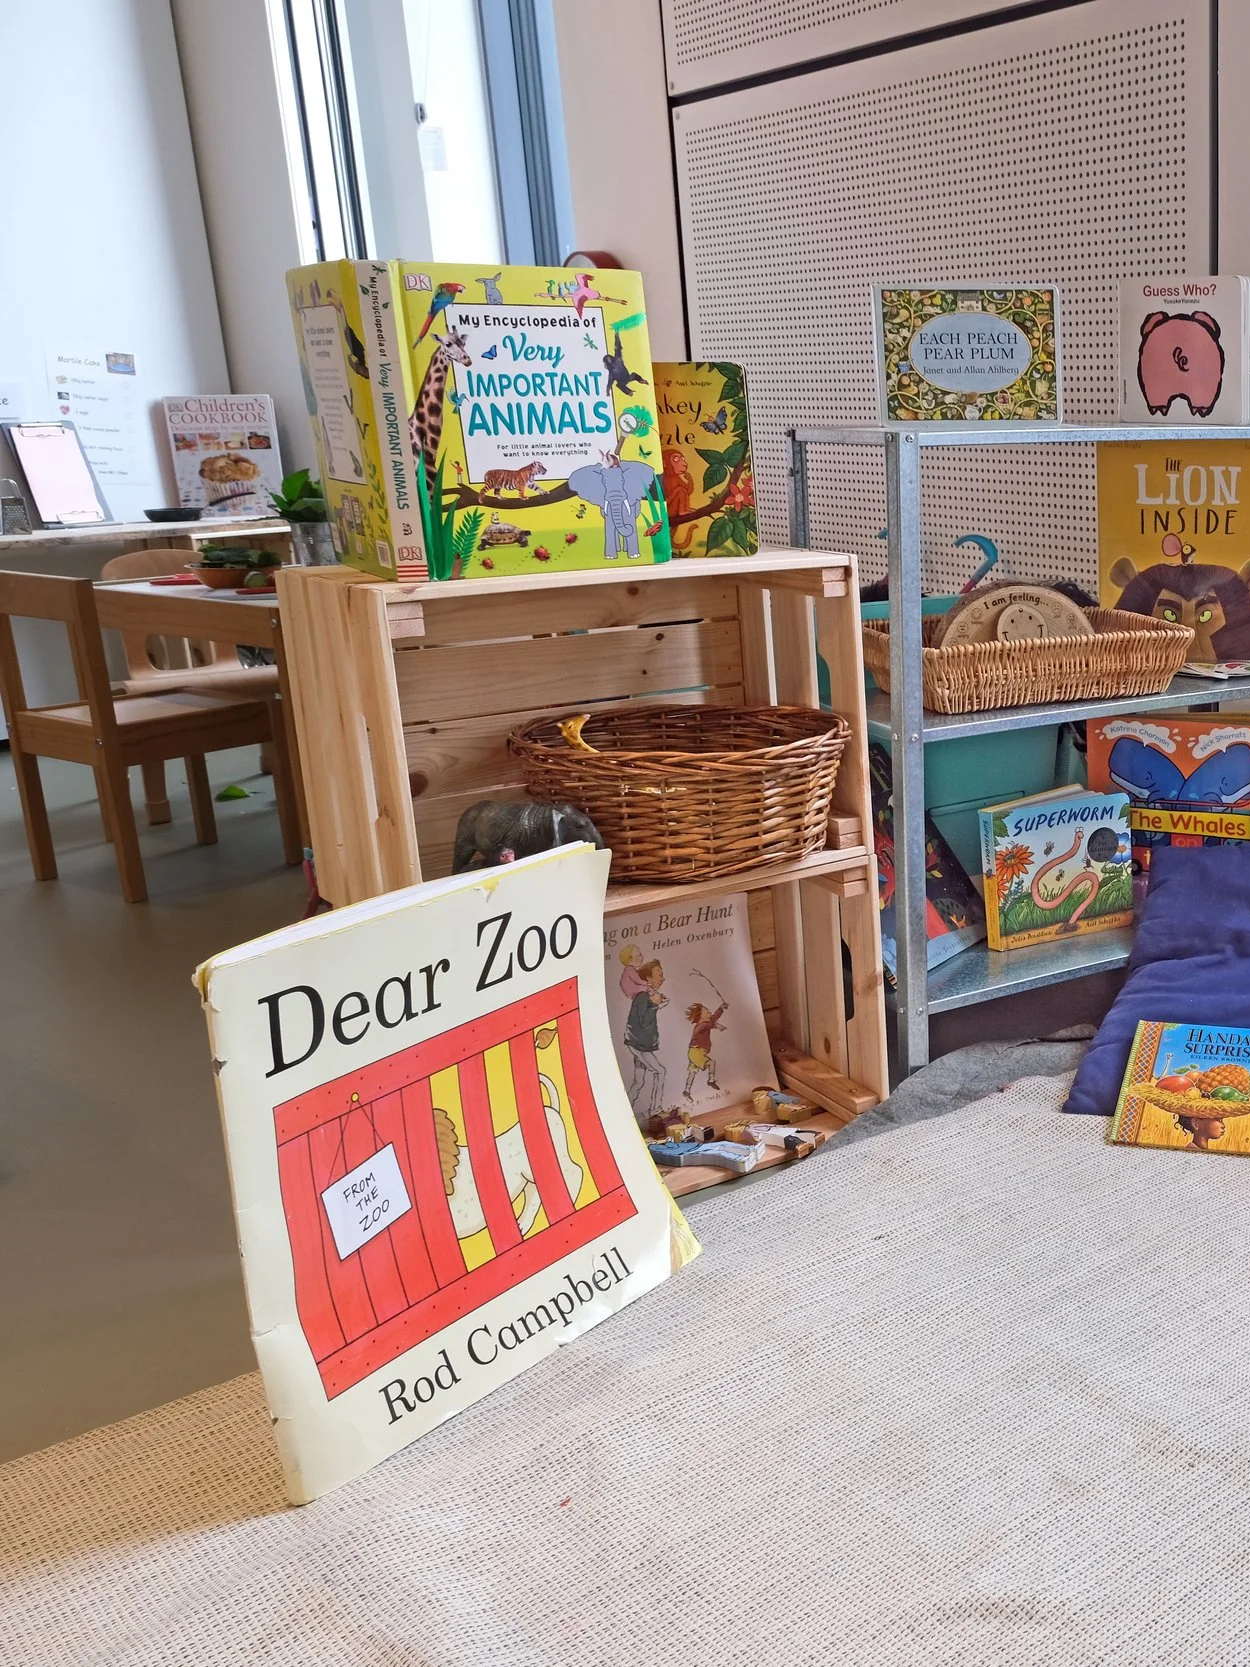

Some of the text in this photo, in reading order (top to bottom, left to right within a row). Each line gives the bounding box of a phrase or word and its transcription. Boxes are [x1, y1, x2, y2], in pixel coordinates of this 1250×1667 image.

[406, 275, 430, 290] DK
[1143, 283, 1217, 297] Guess Who?
[458, 314, 597, 329] My Encyclopedia of
[919, 332, 1018, 345] EACH PEACH
[57, 355, 101, 367] Marble Cake
[502, 332, 565, 369] Very
[924, 347, 1015, 360] PEAR PLUM
[923, 366, 1019, 376] Janet and Allan Ahlberg
[369, 276, 410, 510] My Encyclopedia of Very IMPORTANT ANIMALS
[466, 370, 602, 398] IMPORTANT
[184, 398, 266, 412] Children's
[168, 411, 269, 425] COOKBOOK
[468, 401, 612, 437] ANIMALS
[551, 449, 588, 457] everything
[1165, 457, 1182, 471] THE
[1139, 507, 1238, 535] INSIDE
[400, 547, 422, 561] DK
[992, 596, 1006, 607] am
[1109, 726, 1170, 748] Katrina Charman
[1200, 731, 1247, 752] Nick Sharratt
[1013, 805, 1115, 837] SUPERWORM
[1130, 810, 1247, 837] The Whales
[982, 820, 991, 865] SUPERWORM
[1175, 837, 1198, 848] on
[621, 925, 638, 939] on
[643, 923, 651, 935] a
[657, 914, 692, 932] Bear
[696, 904, 734, 924] Hunt
[652, 927, 735, 951] Helen Oxenbury
[1011, 934, 1026, 944] Julia
[256, 910, 580, 1079] Dear Zoo
[343, 1172, 376, 1203] FROM
[355, 1185, 379, 1211] THE
[359, 1199, 390, 1232] ZOO
[378, 1247, 634, 1425] Rod Campbell
